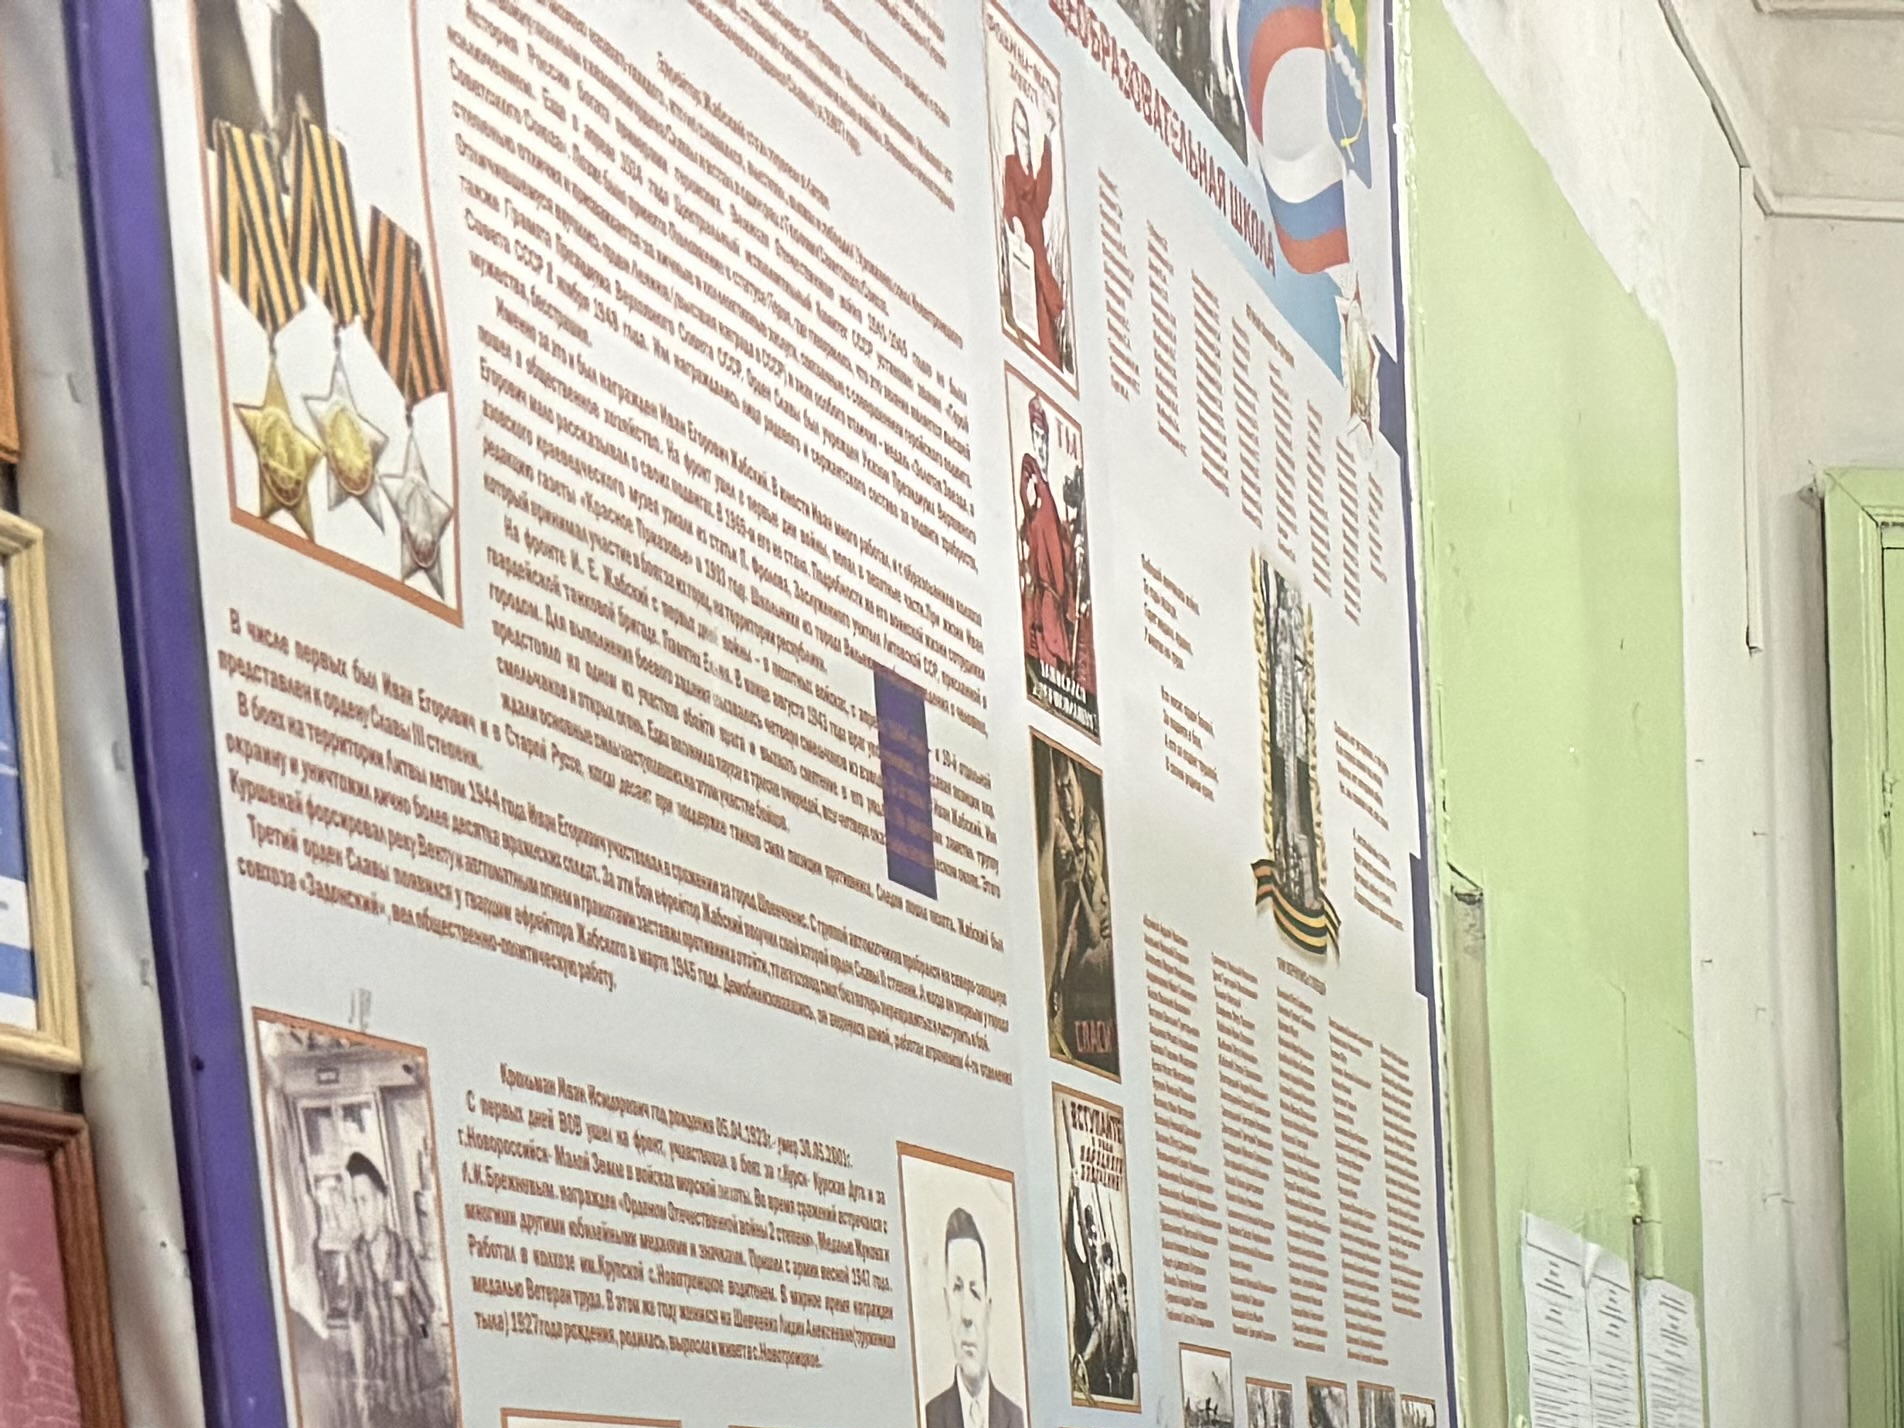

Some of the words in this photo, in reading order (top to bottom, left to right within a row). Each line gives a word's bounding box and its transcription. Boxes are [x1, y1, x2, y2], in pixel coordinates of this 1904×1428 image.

[1229, 180, 1276, 278] ШКОЛА
[687, 419, 730, 465] Егорович
[229, 607, 242, 636] В
[246, 621, 290, 656] числе
[294, 639, 349, 680] первых
[351, 657, 379, 692] был
[382, 672, 414, 707] Иван
[417, 687, 477, 734] Егорович
[504, 722, 547, 761] Старой
[369, 703, 412, 743] Славы
[305, 722, 385, 770] территории
[468, 779, 501, 812] 1944
[345, 846, 390, 882] Славы
[671, 954, 697, 982] 1945
[557, 1076, 588, 1104] Иван
[465, 1089, 476, 1113] С
[479, 1097, 525, 1124] первых
[527, 1107, 555, 1131] дней
[557, 1110, 583, 1137] ВОВ
[616, 1129, 630, 1149] на
[553, 1143, 591, 1172] Малой
[464, 1202, 517, 1227] многими
[519, 1212, 566, 1236] другими
[568, 1215, 638, 1248] юбилейными
[767, 1220, 776, 1241] 2
[467, 1233, 517, 1263] Работал
[519, 1246, 529, 1265] в
[532, 1248, 576, 1272] колхозе
[851, 1267, 871, 1288] 1947
[470, 1275, 525, 1299] медалью
[525, 1276, 573, 1309] Ветеран
[605, 1288, 615, 1312] В
[615, 1294, 641, 1315] этом
[656, 1301, 677, 1325] году
